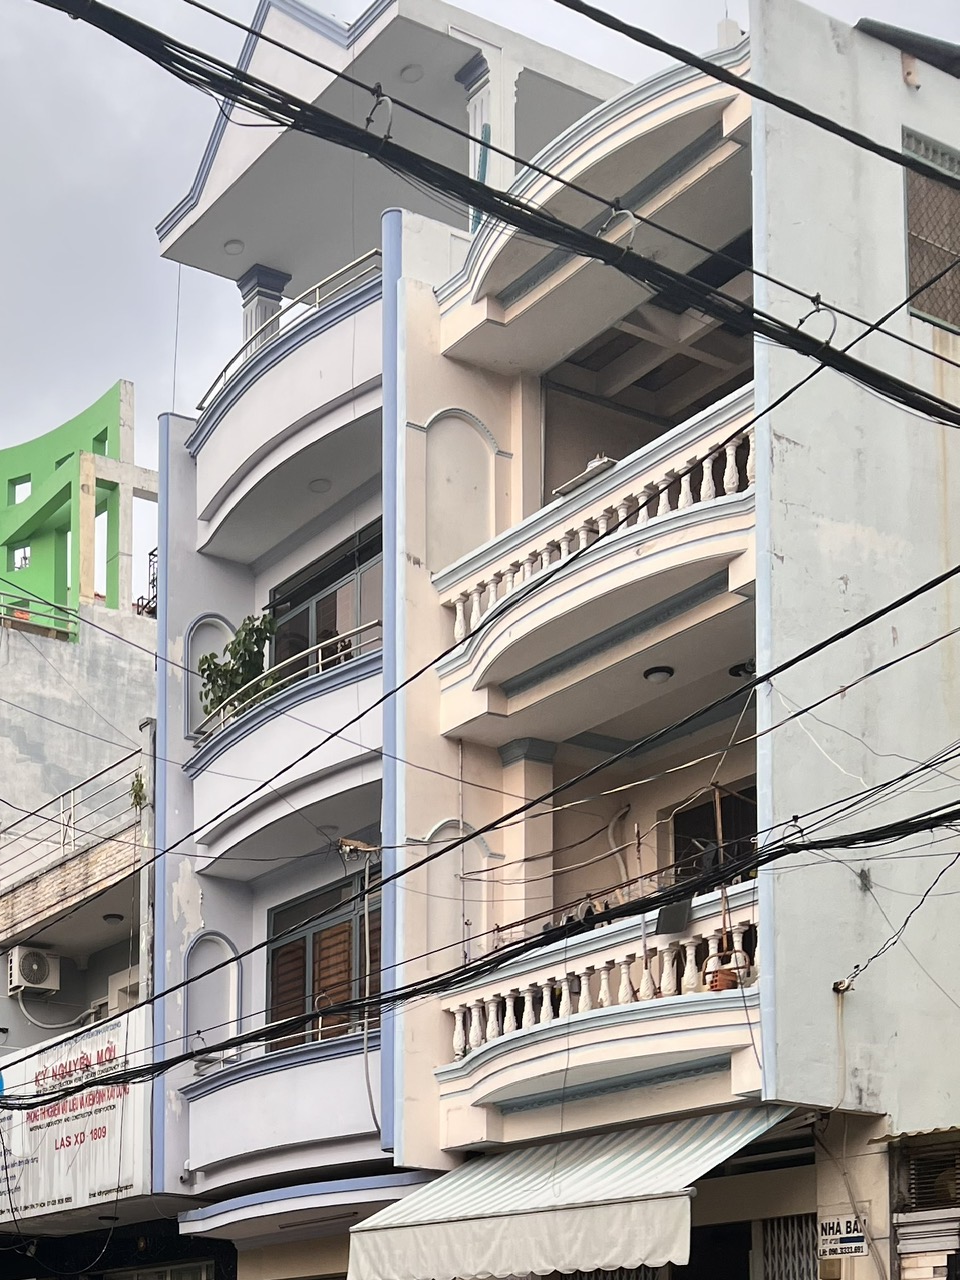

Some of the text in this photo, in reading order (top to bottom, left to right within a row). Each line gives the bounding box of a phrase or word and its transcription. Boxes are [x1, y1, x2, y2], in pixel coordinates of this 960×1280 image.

[55, 1135, 72, 1150] LAS
[90, 1125, 107, 1141] 1809
[821, 1217, 842, 1236] NHÀ
